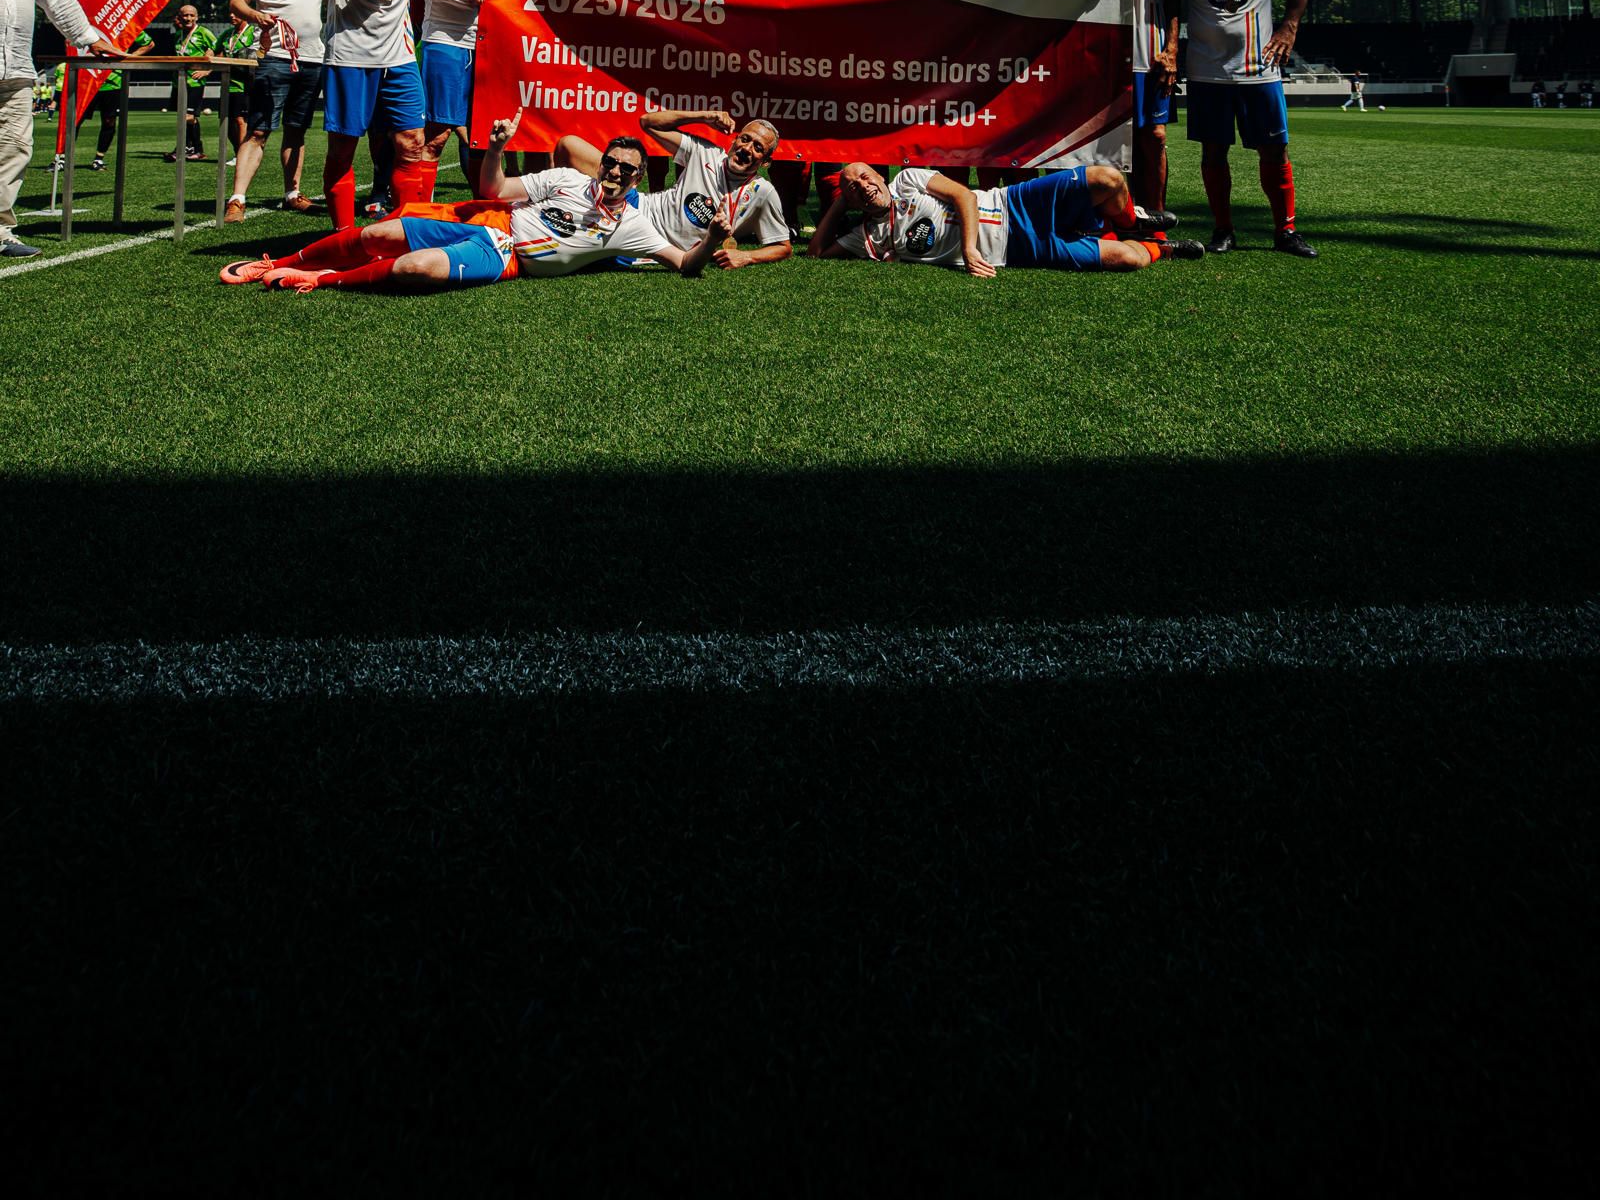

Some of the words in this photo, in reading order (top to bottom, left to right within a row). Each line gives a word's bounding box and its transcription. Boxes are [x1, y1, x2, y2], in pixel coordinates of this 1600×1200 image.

[103, 4, 125, 29] LIGUE
[110, 19, 128, 39] LEGA
[521, 35, 656, 73] Vainqueur
[662, 43, 741, 78] Coupe
[748, 49, 832, 78] Suisse
[839, 53, 885, 80] des
[892, 56, 990, 84] seniors
[997, 57, 1051, 84] 50+
[518, 80, 638, 113] Vincitore
[730, 90, 838, 121] Svizzera
[845, 98, 936, 126] seniori
[943, 100, 996, 127] 50+
[688, 201, 708, 224] Galicia
[693, 195, 714, 219] Estrella
